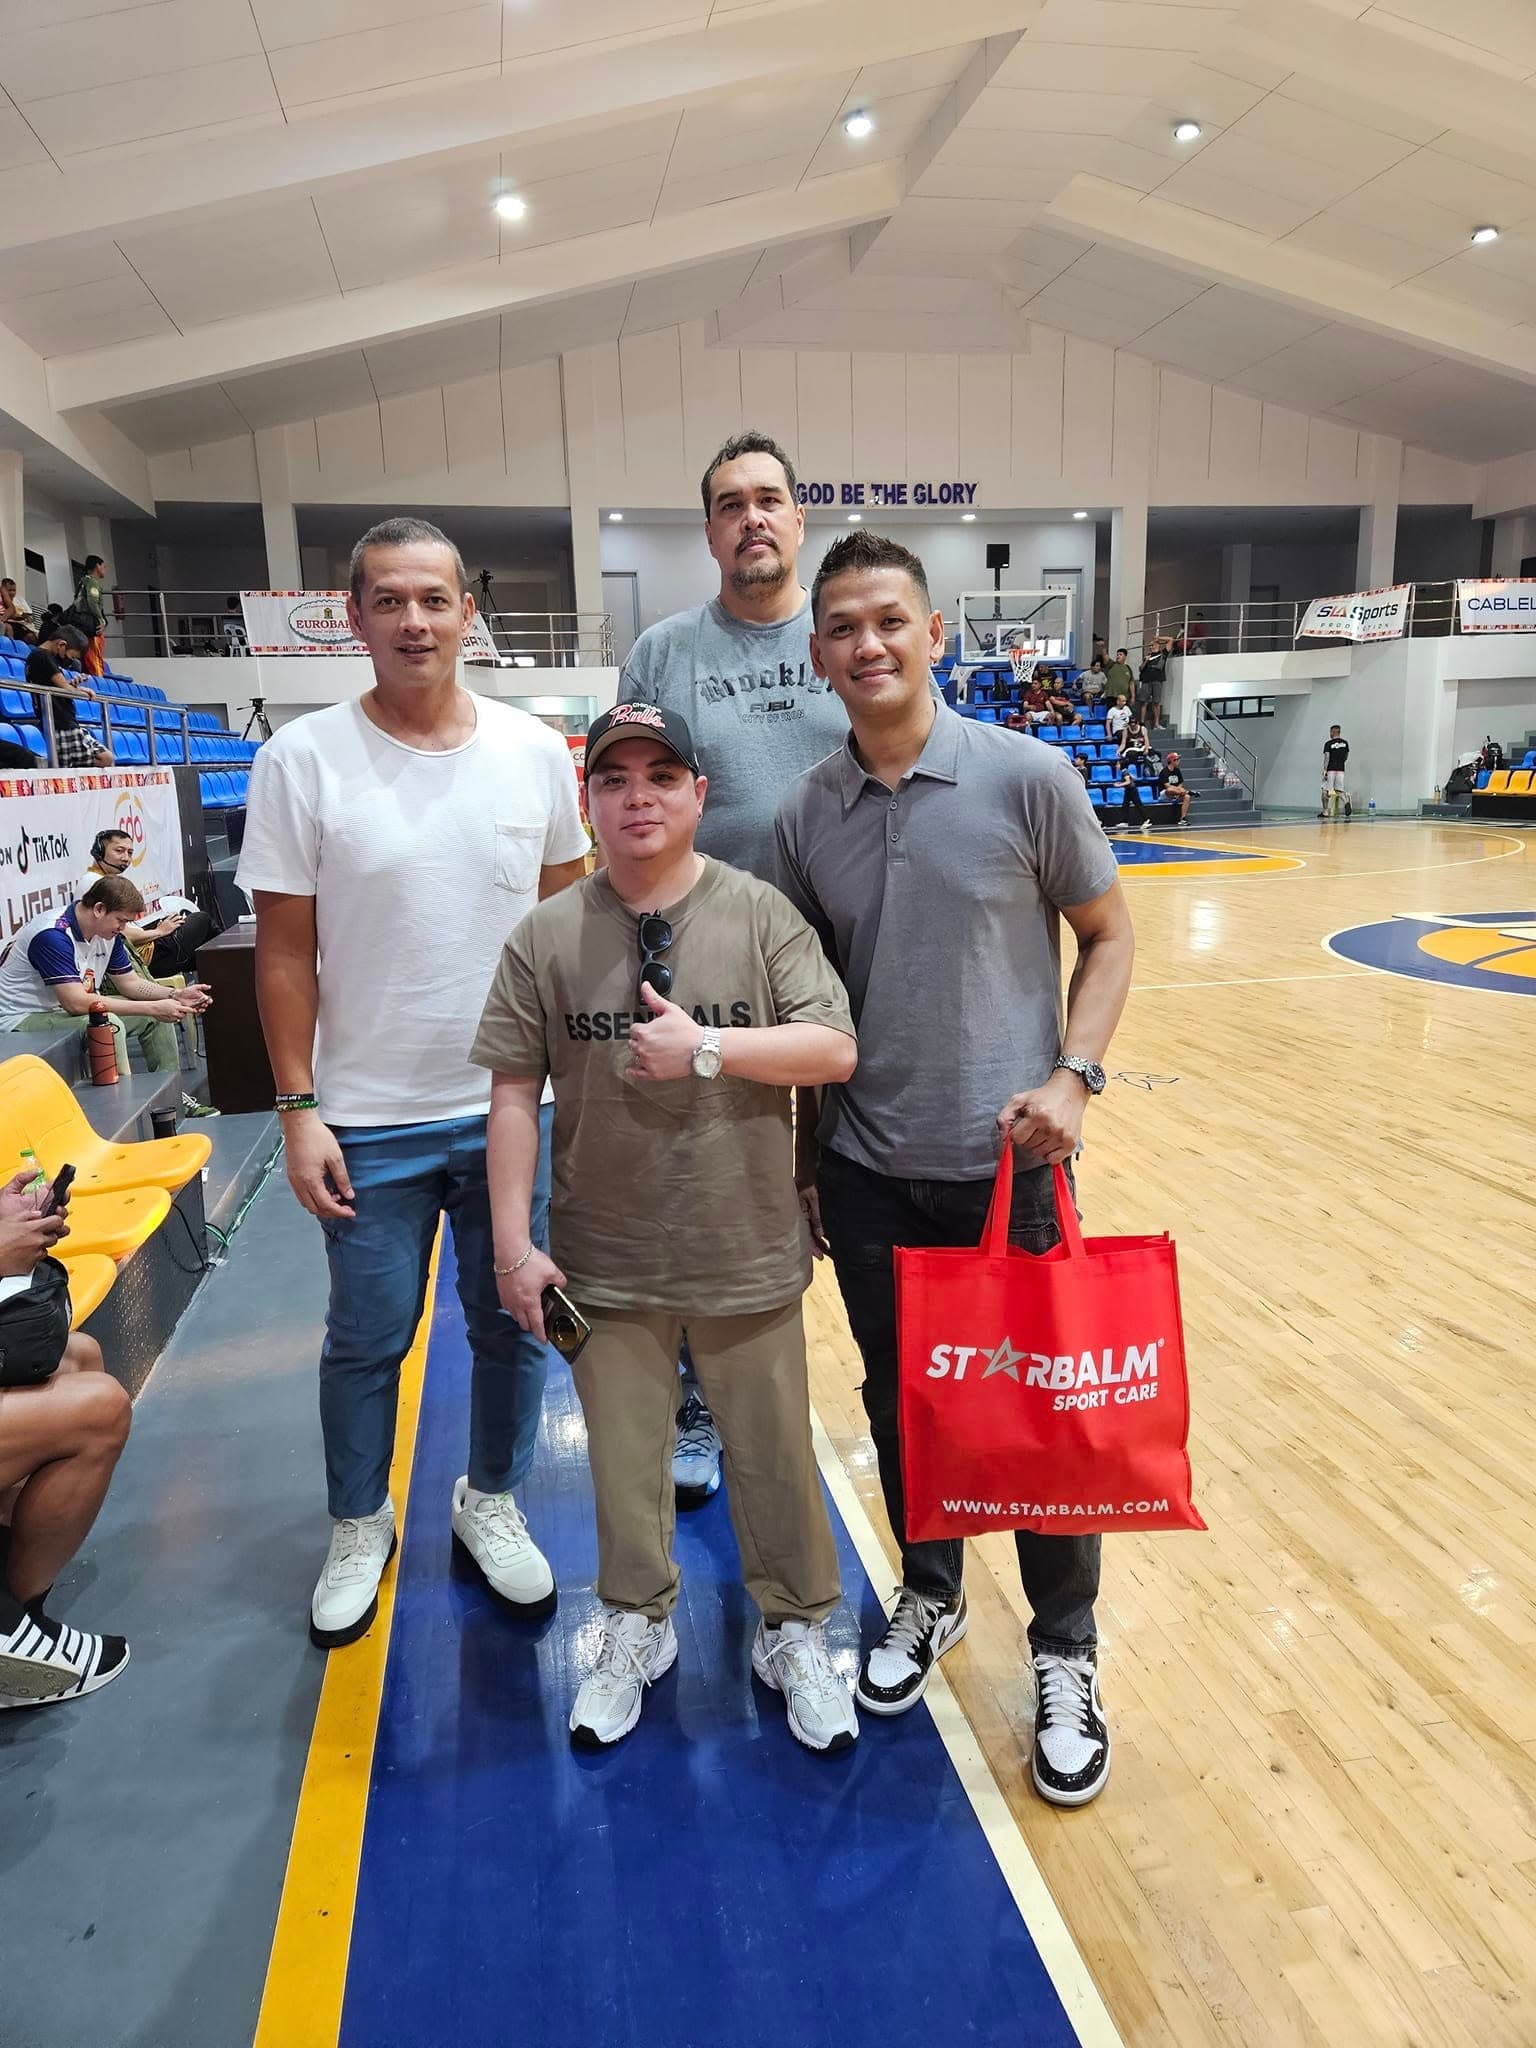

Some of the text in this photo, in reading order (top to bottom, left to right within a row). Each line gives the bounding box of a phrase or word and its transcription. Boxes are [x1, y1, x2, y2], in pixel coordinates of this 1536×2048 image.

[797, 483, 977, 505] GOD BE THE GLORY
[1350, 603, 1398, 624] Sports
[609, 704, 665, 728] Bulls
[750, 699, 794, 713] FUBU
[32, 833, 70, 863] TikTok
[1052, 1382, 1159, 1412] SPORT CARE
[942, 1499, 1170, 1517] WWW.STARBALM.COM
